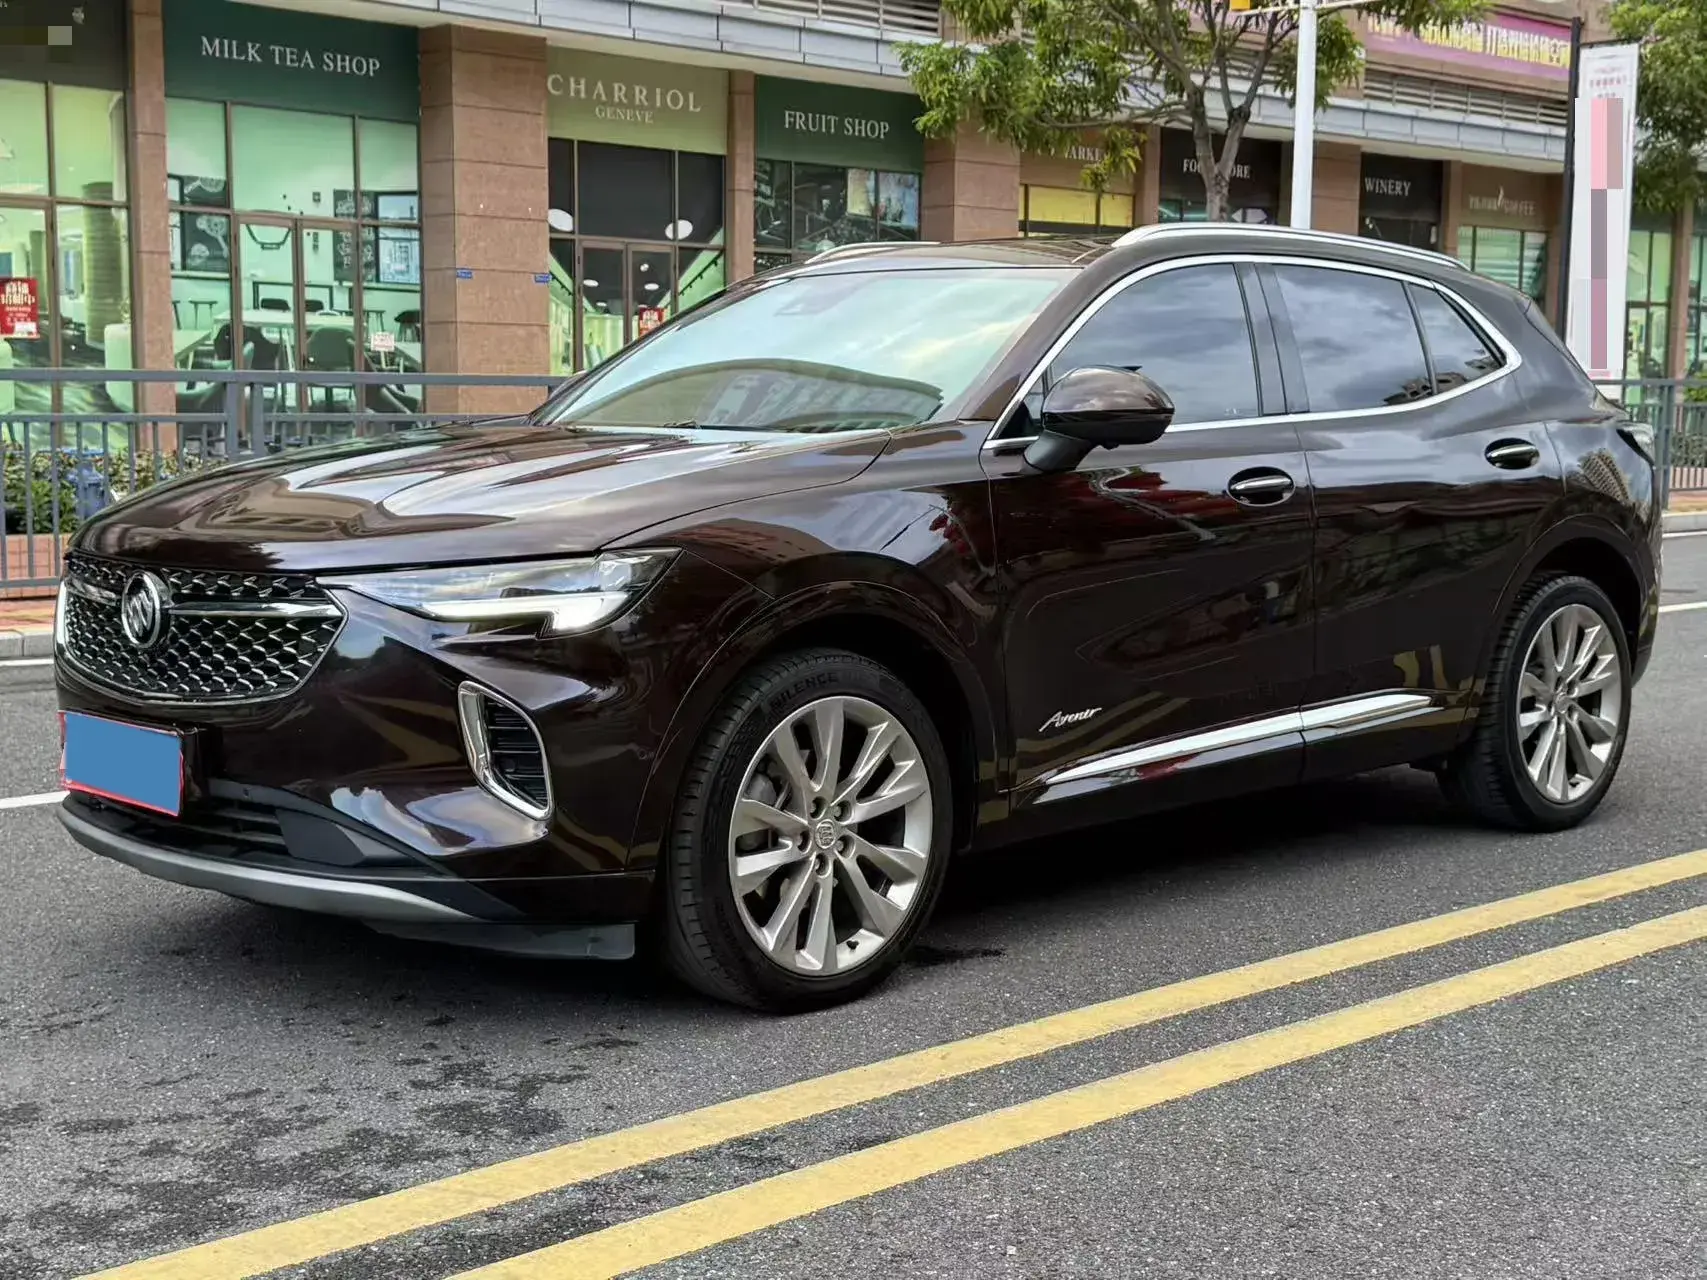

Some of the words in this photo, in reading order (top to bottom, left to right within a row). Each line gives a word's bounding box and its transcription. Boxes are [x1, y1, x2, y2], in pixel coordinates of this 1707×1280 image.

[200, 35, 263, 63] MILK
[269, 44, 316, 70] TEA
[322, 51, 381, 77] SHOP
[546, 73, 702, 113] CHARRIOL
[594, 104, 655, 124] GENEVE
[784, 109, 839, 135] FRUIT
[843, 116, 890, 140] SHOP
[1364, 177, 1412, 197] WINERY
[1038, 707, 1103, 733] Avenir
